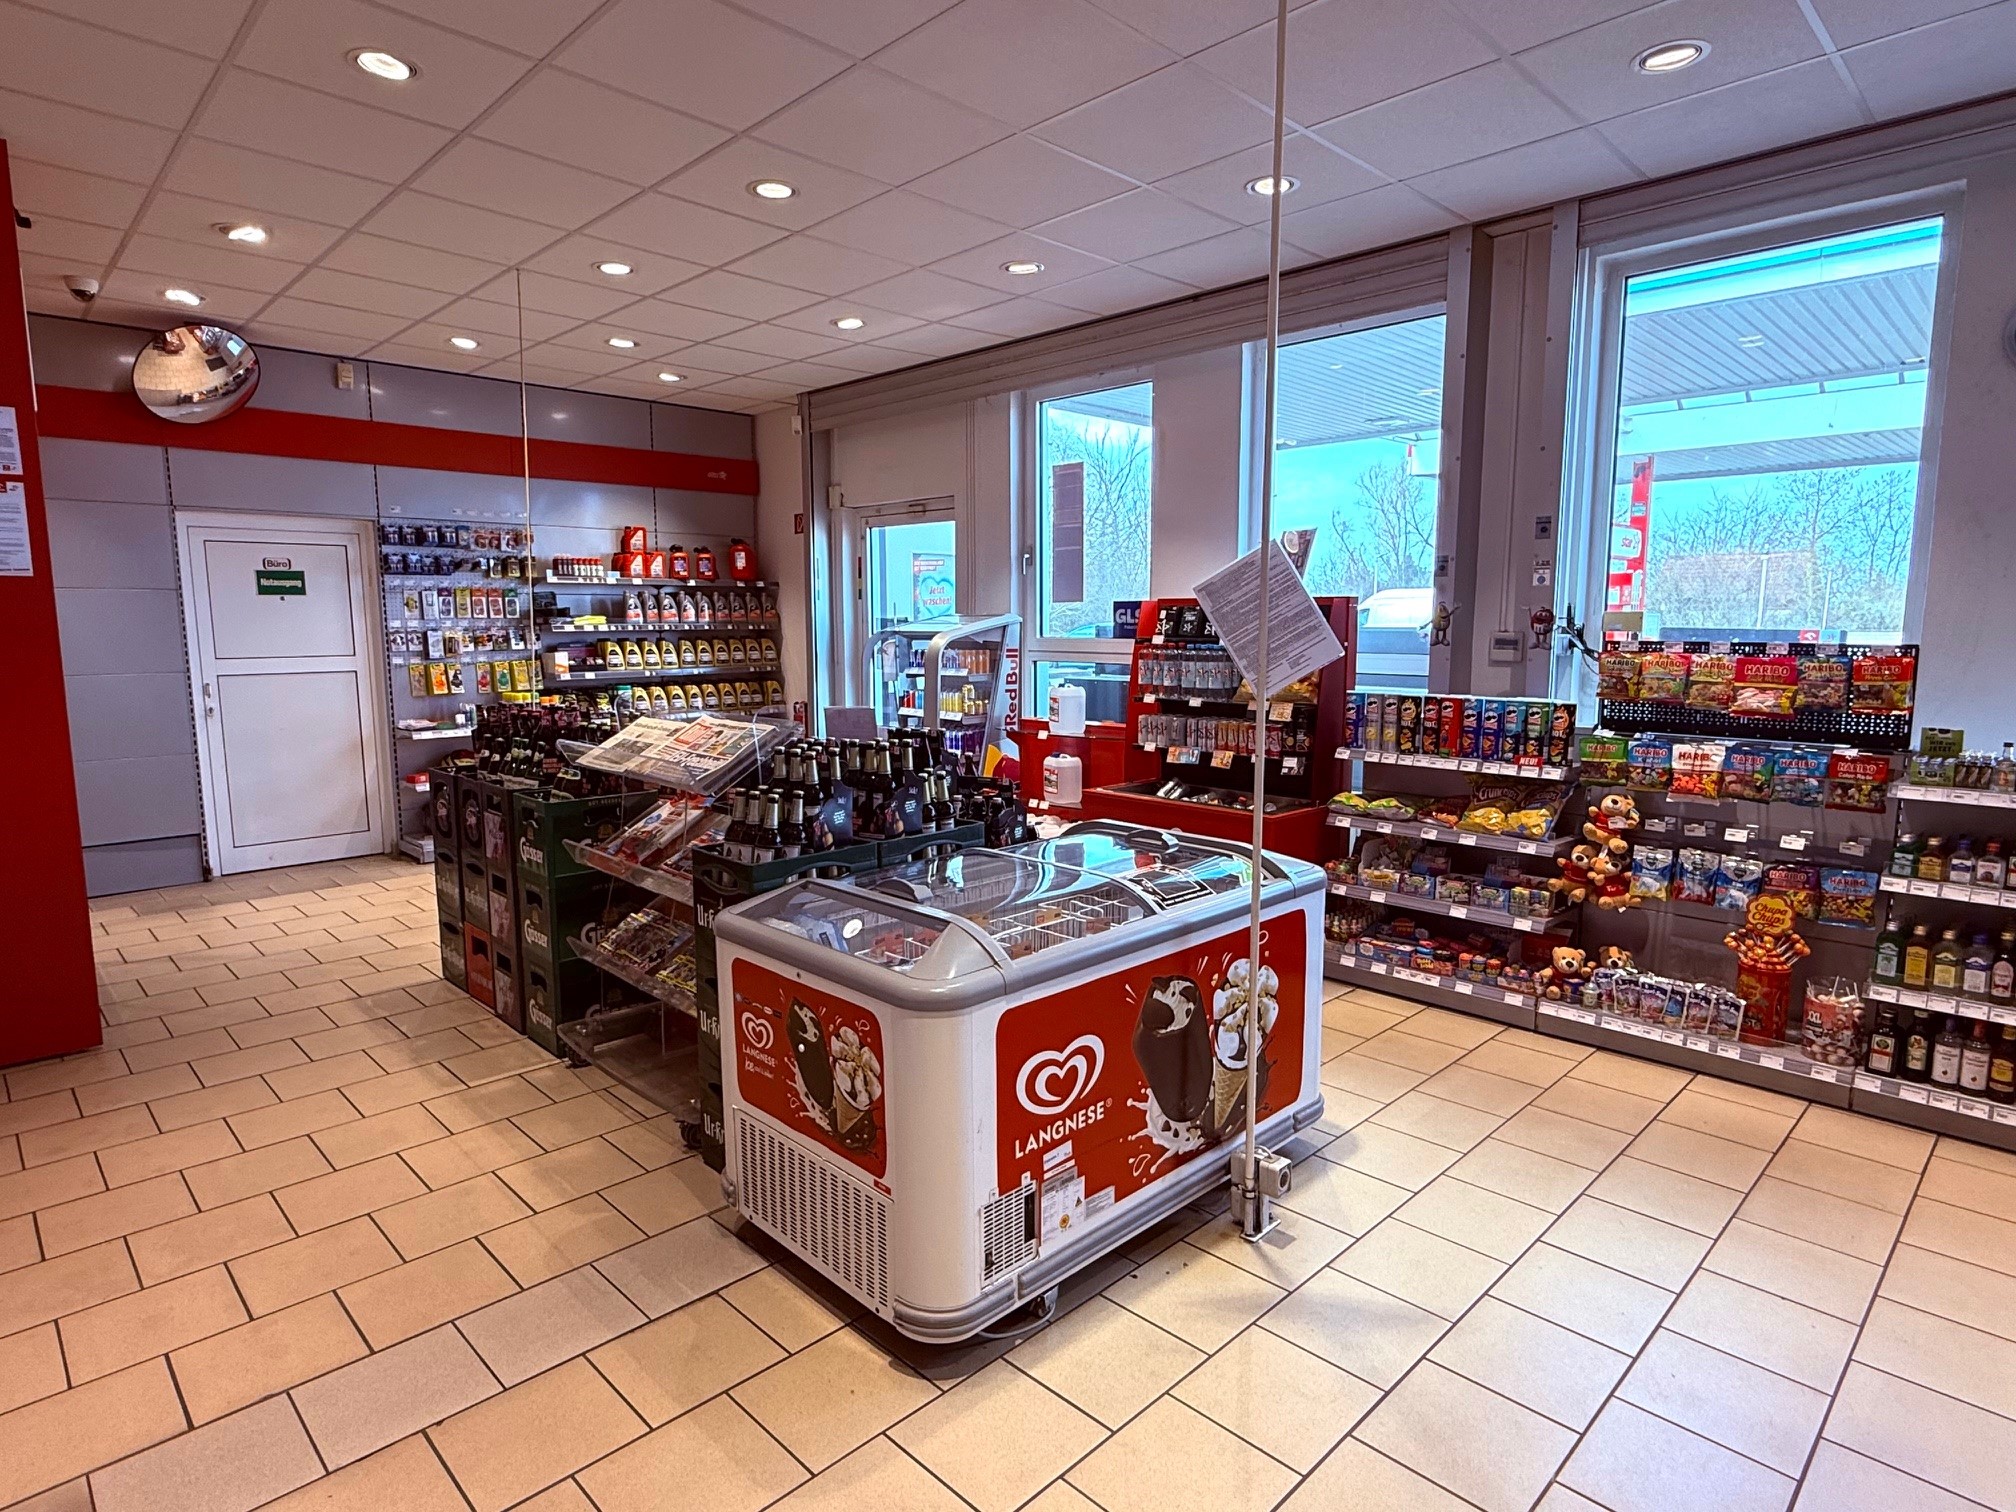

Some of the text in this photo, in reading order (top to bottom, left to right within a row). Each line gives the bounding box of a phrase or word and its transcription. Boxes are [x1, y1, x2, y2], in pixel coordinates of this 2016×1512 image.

[266, 559, 288, 568] Büro
[929, 586, 945, 595] Jetzt
[1115, 608, 1140, 624] GLS
[1606, 658, 1636, 668] HARIBO
[1647, 659, 1684, 669] HARIBO
[1695, 661, 1735, 672] HARIBO
[1802, 664, 1844, 673] HARIBO
[1744, 664, 1791, 676] HARIBO
[1861, 665, 1902, 675] HARIBO
[1004, 648, 1019, 727] Red Bull
[1587, 744, 1618, 753] HARIBO
[1632, 746, 1669, 758] HARIBO
[1519, 757, 1539, 766] NEU!
[1677, 751, 1721, 762] HARIB
[1730, 754, 1766, 766] HARIBO
[1778, 757, 1818, 769] HARIBO
[1837, 761, 1877, 774] HARIBO
[1769, 870, 1807, 881] HARIBO
[1828, 876, 1868, 887] HARIBO
[1754, 902, 1788, 916] Chupa
[1751, 911, 1785, 926] Chups
[1807, 1010, 1822, 1024] XXL
[742, 1042, 776, 1068] LANGNESE
[1014, 1100, 1105, 1160] LANGNESE
